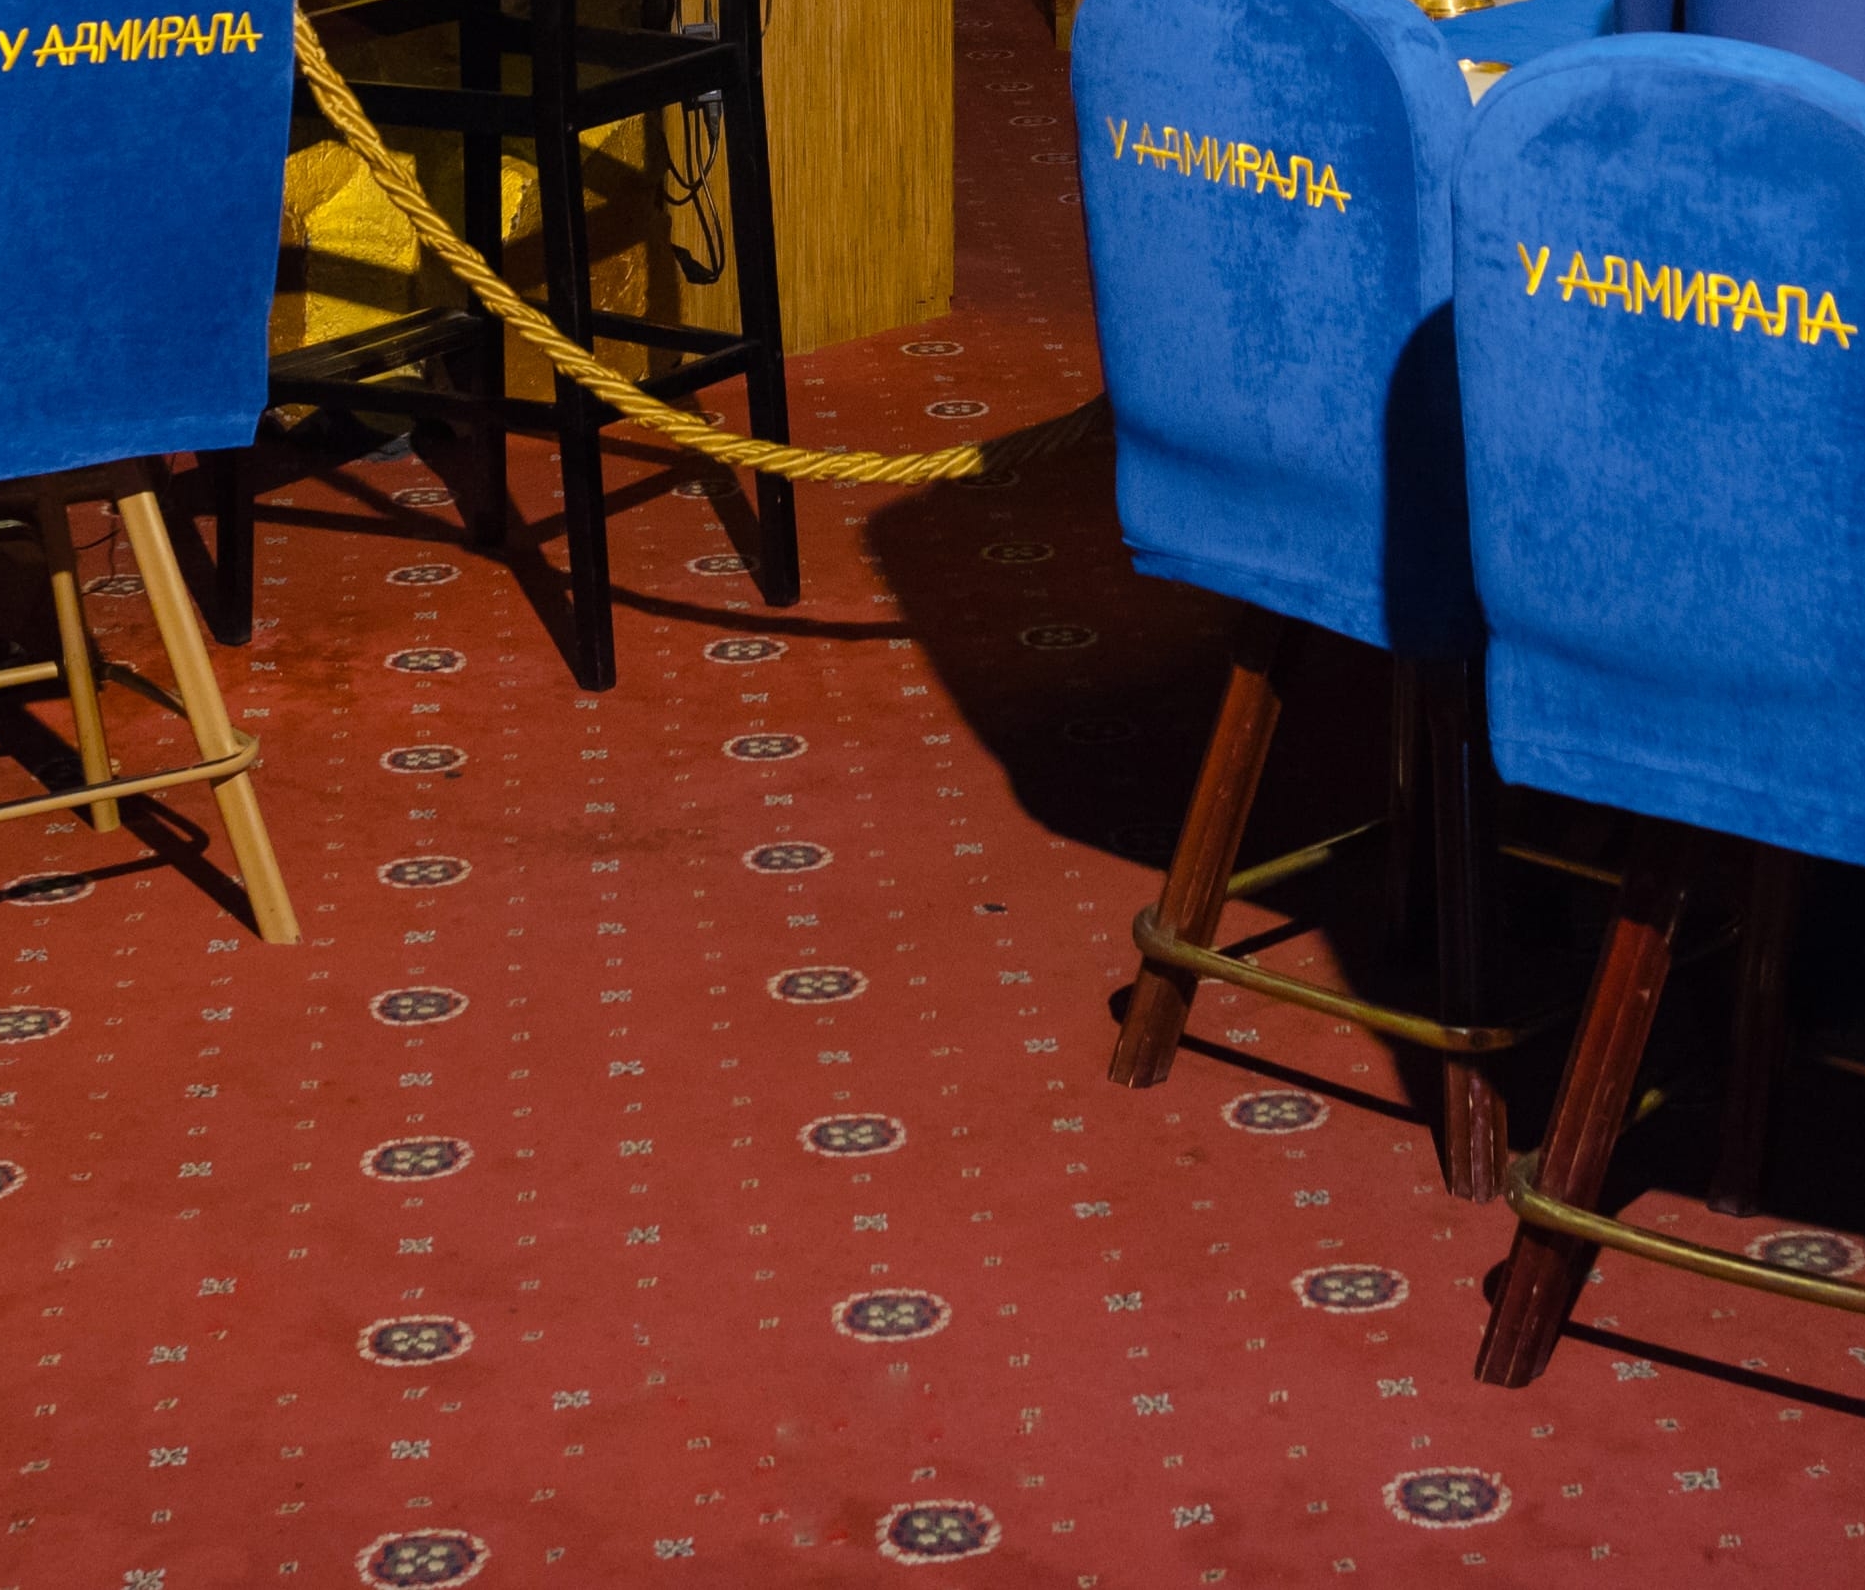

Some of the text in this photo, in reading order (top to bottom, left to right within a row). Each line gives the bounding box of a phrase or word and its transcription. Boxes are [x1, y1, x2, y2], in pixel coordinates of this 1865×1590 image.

[32, 11, 263, 68] АДМИРАЛА
[1105, 116, 1352, 213] У АДМИРАЛА
[1517, 241, 1857, 350] У АДМИРАЛА
